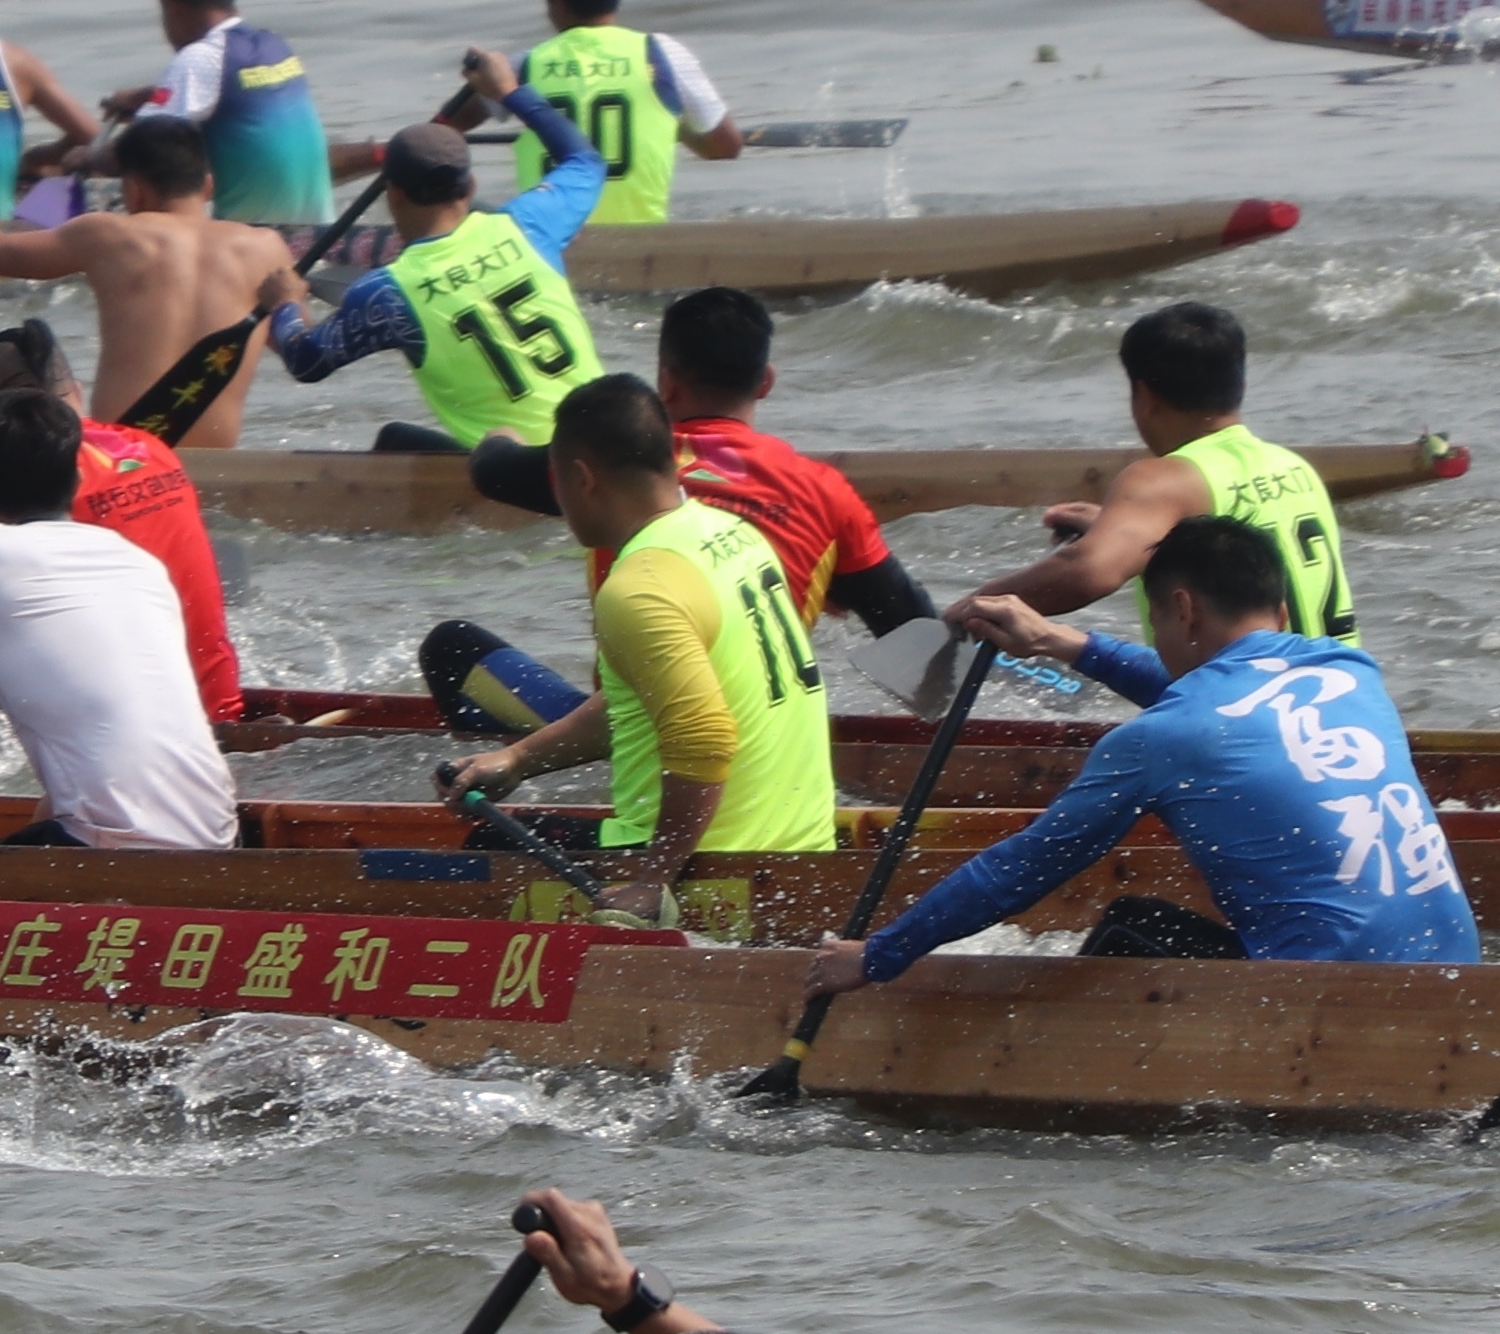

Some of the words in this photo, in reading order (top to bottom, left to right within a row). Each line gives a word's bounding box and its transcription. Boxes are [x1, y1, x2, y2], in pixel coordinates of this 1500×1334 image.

[541, 55, 633, 80] 大良大门
[418, 238, 525, 306] 大良大门
[454, 274, 576, 404] 15
[1227, 467, 1315, 510] 大良大门
[1215, 657, 1462, 898] 富强
